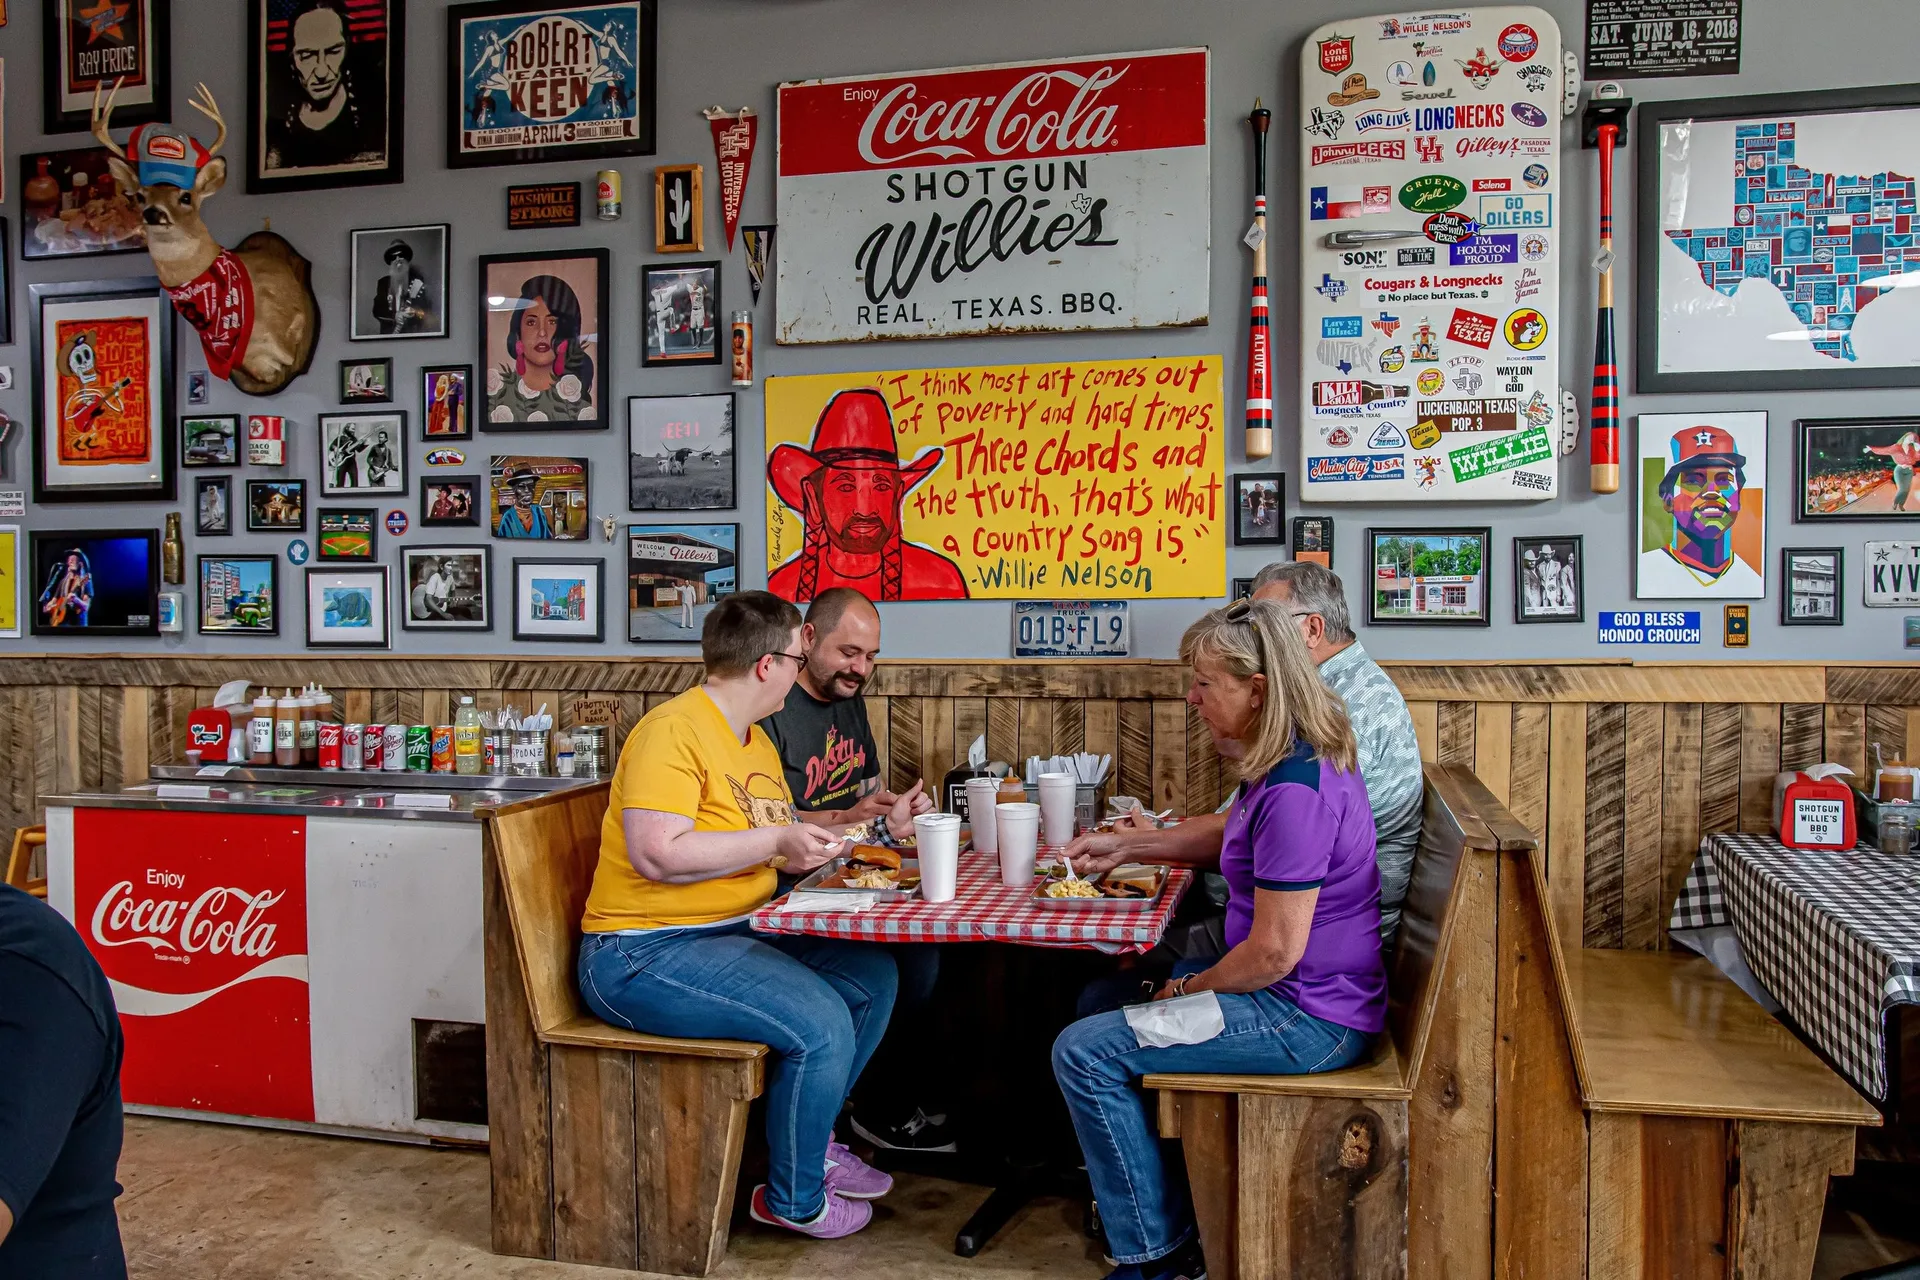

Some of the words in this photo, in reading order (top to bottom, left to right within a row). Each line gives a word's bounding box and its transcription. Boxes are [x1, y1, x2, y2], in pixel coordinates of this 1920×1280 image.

[1403, 24, 1429, 33] WILLIE
[1434, 21, 1472, 30] NELSON'S
[1591, 24, 1624, 45] SAT.
[1632, 22, 1674, 42] JUNE
[1682, 20, 1702, 40] 16,
[1706, 19, 1738, 39] 2018
[506, 20, 594, 71] ROBERT
[1324, 48, 1348, 56] LONE
[1500, 42, 1537, 53] ASTROS
[1634, 41, 1694, 52] 2PM
[79, 50, 100, 76] RAY
[102, 45, 136, 74] PRICE
[1324, 54, 1348, 64] STAR
[515, 66, 584, 80] EARL
[1516, 64, 1553, 80] CHARGE!!!
[510, 76, 588, 118] KEEN
[843, 87, 881, 104] Enjoy
[1401, 88, 1456, 100] Servel
[857, 64, 1132, 164] Coca-Cola
[1355, 113, 1382, 132] LONG
[1386, 111, 1412, 126] LIVE
[1416, 104, 1504, 132] LONGNECKS
[522, 124, 562, 144] APRIL
[564, 122, 576, 142] 3
[734, 162, 744, 206] UNIVERSITY
[886, 159, 1088, 204] SHOTGUN
[1406, 178, 1460, 192] GRUENE
[1478, 180, 1506, 189] Selena
[510, 190, 574, 206] NASHVILLE
[1414, 188, 1447, 206] Hall
[1505, 197, 1524, 210] GO
[510, 203, 574, 220] STRONG
[1486, 211, 1544, 226] OILERS
[1438, 213, 1459, 226] Don't
[1448, 226, 1464, 236] with
[1476, 236, 1492, 244] I'M
[1814, 237, 1850, 246] SXSW
[1400, 254, 1412, 262] BBQ
[1416, 252, 1432, 262] TIME
[1456, 244, 1511, 256] HOUSTON
[1339, 250, 1388, 266] "SON!"
[1464, 254, 1503, 264] PROUD
[1522, 268, 1536, 278] Phi
[1774, 268, 1792, 286] T
[1364, 278, 1416, 292] Cougars
[1420, 276, 1430, 288] &
[1434, 274, 1503, 289] Longnecks
[1514, 278, 1542, 290] Slama
[1388, 294, 1401, 302] No
[1403, 292, 1428, 302] place
[1431, 292, 1446, 300] but
[1448, 291, 1478, 299] Texas.
[1514, 287, 1538, 304] Jama
[857, 304, 938, 326] REAL.
[952, 295, 1053, 320] TEXAS.
[1062, 292, 1124, 314] BBQ.
[1324, 318, 1344, 328] Luv
[1348, 320, 1360, 328] ya
[1327, 326, 1358, 336] Blue!
[1454, 324, 1492, 342] TEXAS
[1254, 334, 1264, 375] ALTUVE
[1449, 356, 1462, 367] ZZ
[1463, 356, 1482, 364] TOP
[920, 372, 973, 398] think
[980, 366, 1030, 394] most
[1036, 364, 1072, 392] art
[1081, 364, 1146, 390] comes
[1156, 359, 1208, 394] out
[1496, 366, 1532, 376] WAYLON
[1321, 381, 1359, 404] KILT
[1506, 383, 1524, 392] GOD
[898, 404, 922, 436] of
[937, 396, 1038, 434] poverty
[1040, 396, 1073, 426] and
[1085, 390, 1134, 429] hard
[1141, 391, 1215, 432] times.
[1316, 406, 1362, 416] Longneck
[1367, 399, 1408, 411] Country
[1419, 400, 1482, 416] LUCKENBACH
[1485, 399, 1516, 414] TEXAS
[1412, 424, 1434, 438] Texas
[1452, 417, 1474, 432] POP.
[1476, 417, 1482, 430] 3
[1474, 443, 1488, 451] GOT
[1507, 432, 1524, 442] WITH
[944, 429, 1030, 482] Three
[1034, 429, 1138, 477] Chords
[1152, 432, 1208, 468] and
[1414, 456, 1442, 466] TEXAS
[1452, 434, 1550, 474] WILLIE
[1312, 460, 1345, 476] Music
[1346, 457, 1369, 479] City
[1500, 460, 1524, 470] NIGHT!
[1513, 476, 1533, 484] FOLK
[1514, 470, 1552, 481] KERRVILLE
[1512, 480, 1550, 492] FESTIVAL
[914, 484, 956, 521] the
[965, 478, 1059, 516] truth,
[1070, 476, 1154, 519] that's
[1165, 472, 1222, 521] what
[636, 542, 666, 550] WELCOME
[942, 534, 960, 556] a
[1061, 558, 1152, 592] Nelson
[1052, 601, 1091, 610] TEXAS
[1614, 613, 1642, 626] GOD
[1644, 612, 1685, 626] BLESS
[1020, 616, 1065, 644] 01B
[1077, 616, 1123, 644] FL9
[1600, 628, 1645, 643] HONDO
[1648, 628, 1700, 642] CROUCH
[584, 701, 610, 710] BOTTLE
[804, 734, 854, 800] Dusty
[822, 787, 849, 803] AMERICAN
[1798, 804, 1840, 813] SHOTGUN
[1800, 814, 1838, 822] WILLIE'S
[1810, 824, 1828, 832] BBQ
[146, 868, 186, 890] Enjoy
[91, 880, 288, 958] Coca-Cola
